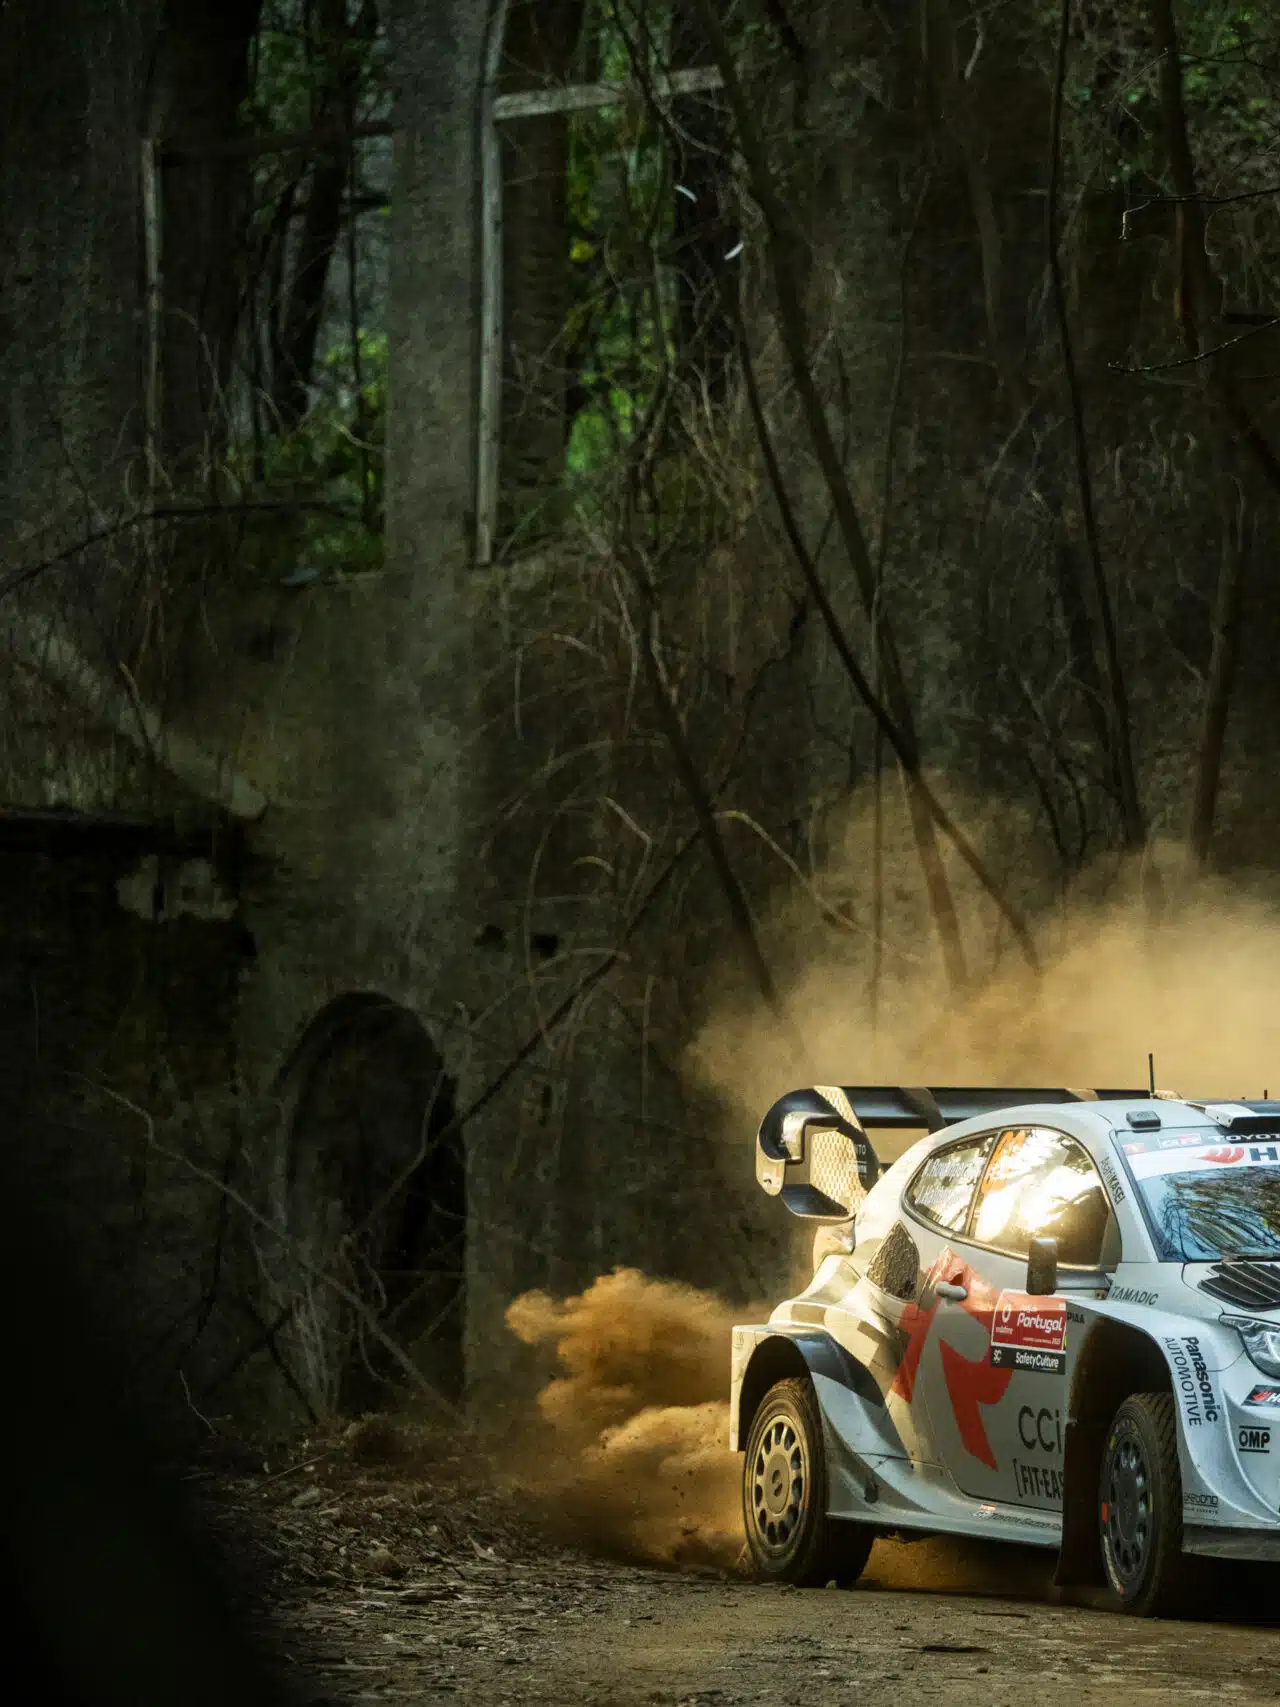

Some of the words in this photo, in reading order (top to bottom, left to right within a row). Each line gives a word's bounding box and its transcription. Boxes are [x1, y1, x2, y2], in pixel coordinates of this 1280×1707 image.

[1111, 1286, 1159, 1305] TAMADIC
[1016, 1312, 1063, 1333] Portugal
[1163, 1336, 1202, 1426] AUTOMOTIVE
[1238, 1430, 1271, 1449] OMP
